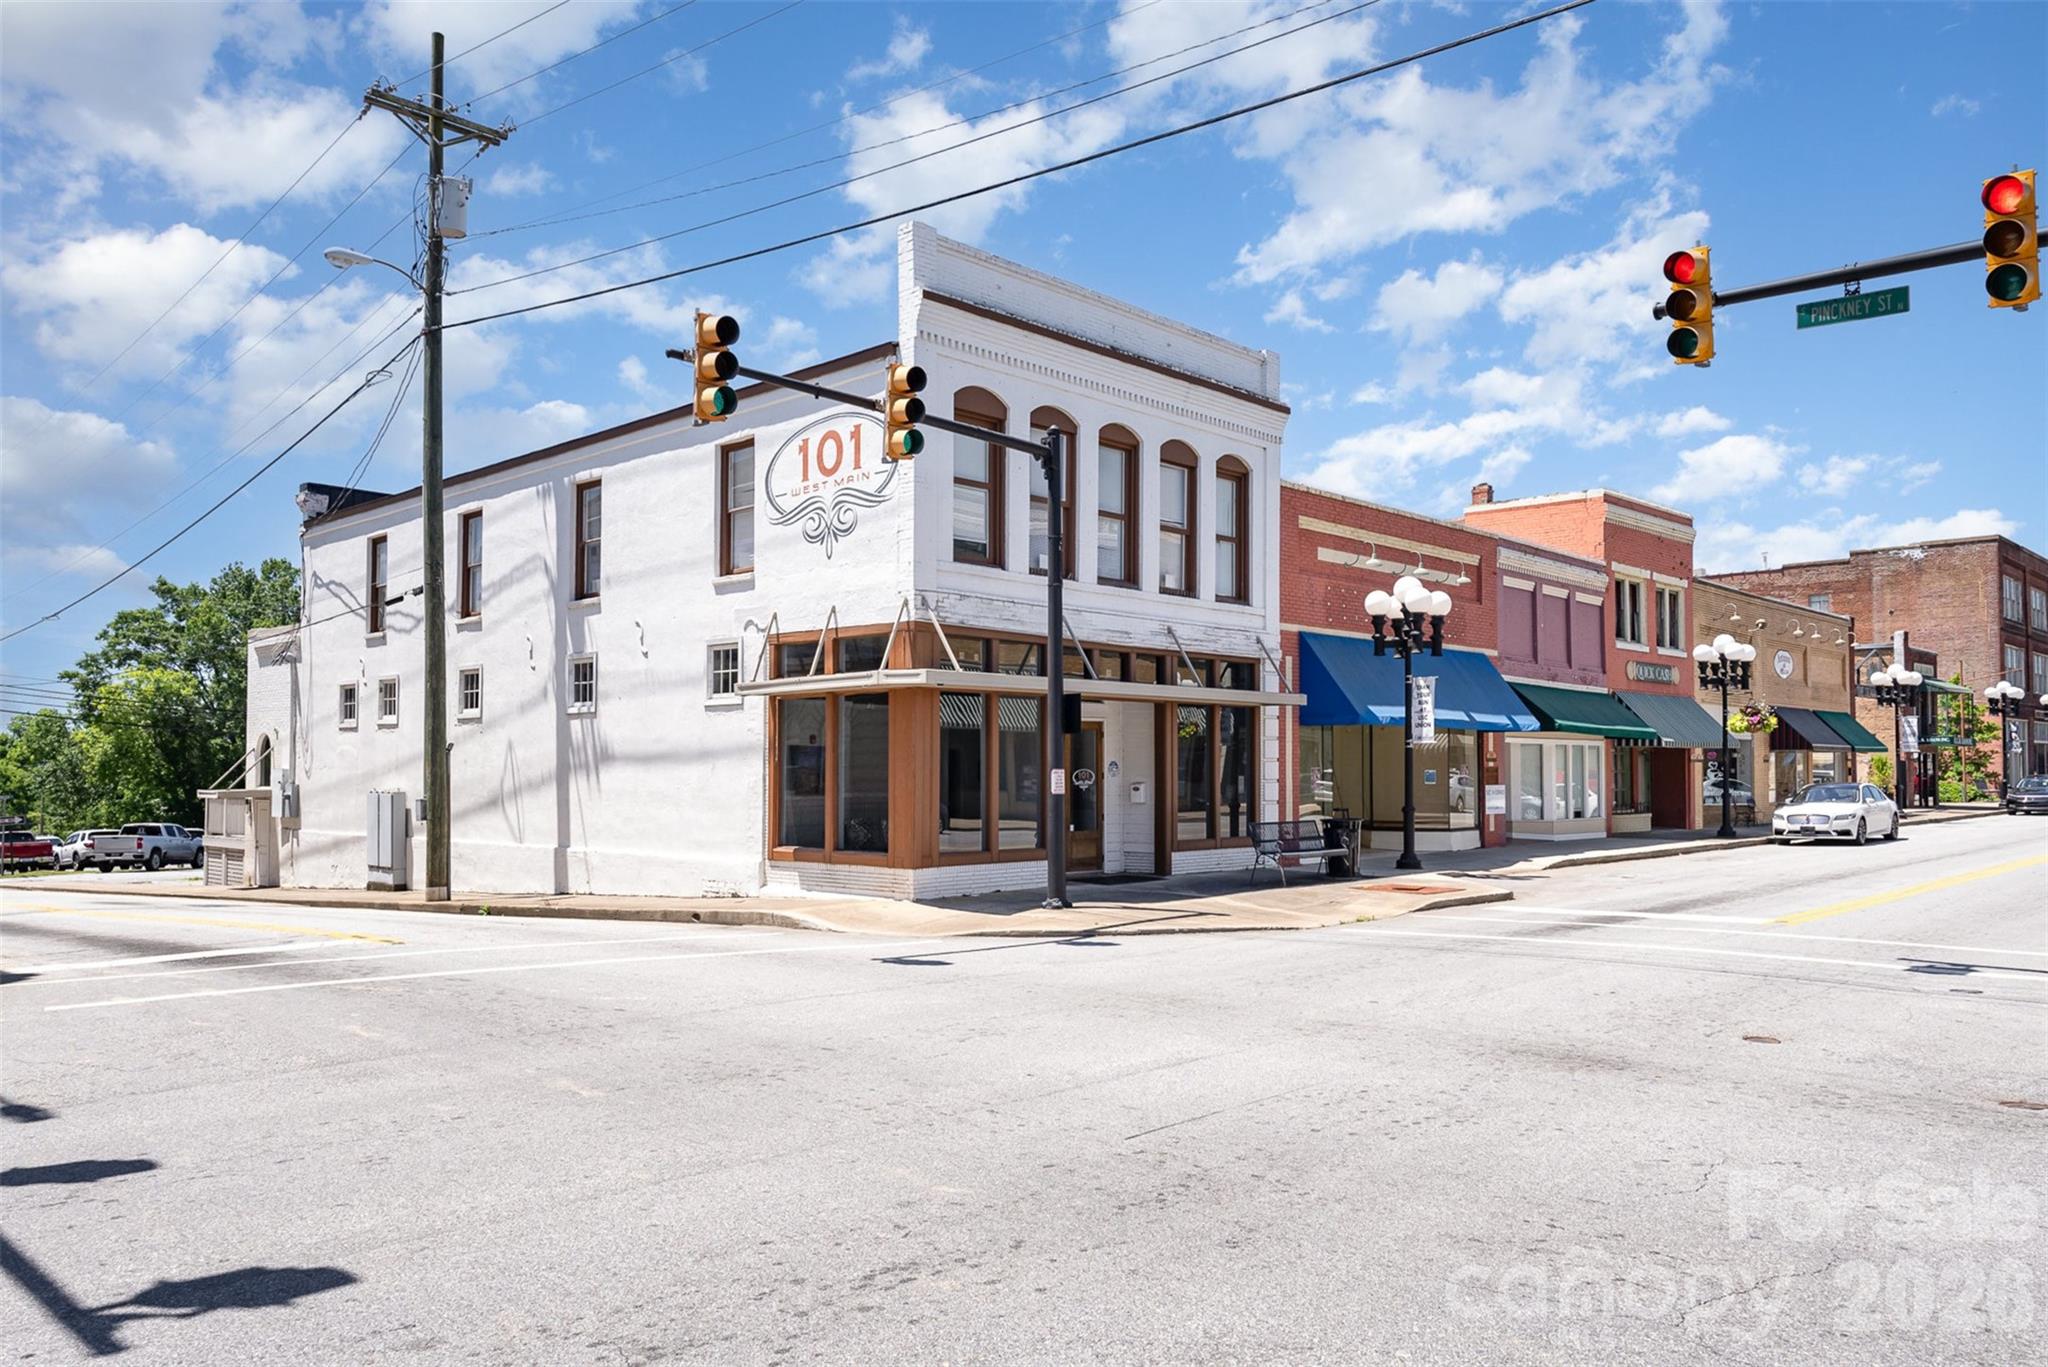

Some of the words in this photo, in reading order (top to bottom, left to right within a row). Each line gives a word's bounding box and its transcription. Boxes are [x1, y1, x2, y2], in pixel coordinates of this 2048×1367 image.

[1811, 298, 1871, 323] PINCKNEY
[1878, 294, 1892, 312] ST
[798, 423, 863, 482] 101
[791, 480, 829, 497] WEST
[833, 471, 871, 487] MAIN
